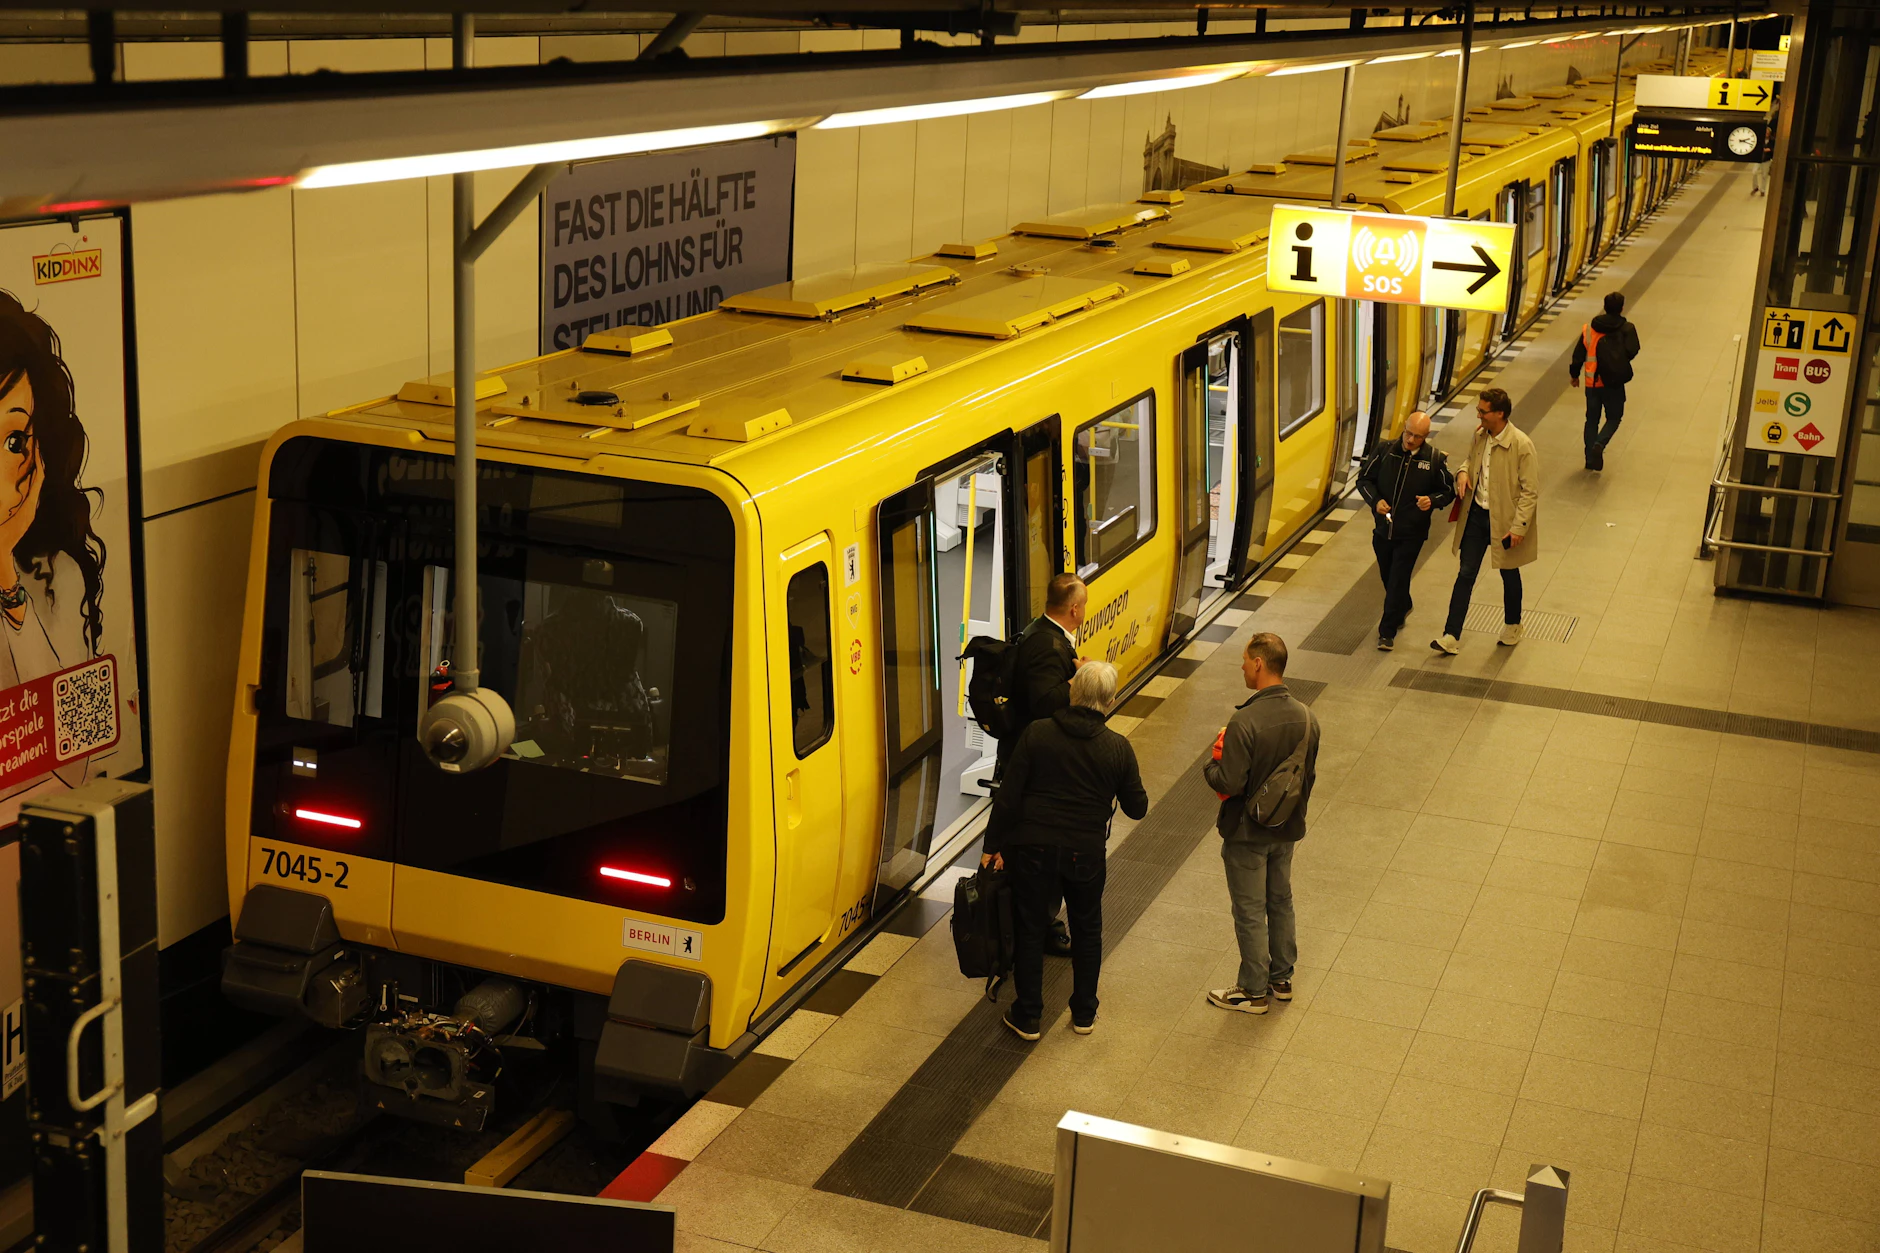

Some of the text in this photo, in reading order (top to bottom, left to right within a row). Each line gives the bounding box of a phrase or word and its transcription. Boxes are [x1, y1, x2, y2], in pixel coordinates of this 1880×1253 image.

[554, 168, 756, 247] FAST DIE HÄLFTE
[37, 254, 99, 280] KIDDINX
[554, 218, 743, 309] DES LOHNS FÜR
[1363, 275, 1402, 295] SOS
[1791, 326, 1799, 343] 1
[1776, 363, 1798, 374] Tram
[1806, 365, 1830, 378] BUS
[1756, 397, 1778, 406] Jelbi
[1797, 431, 1821, 442] Bahn
[1074, 589, 1129, 648] Neuwagen
[1105, 619, 1140, 664] für alle
[850, 650, 861, 664] VBB
[20, 688, 39, 712] die
[261, 847, 350, 889] 7045-2
[629, 928, 671, 946] BERLIN
